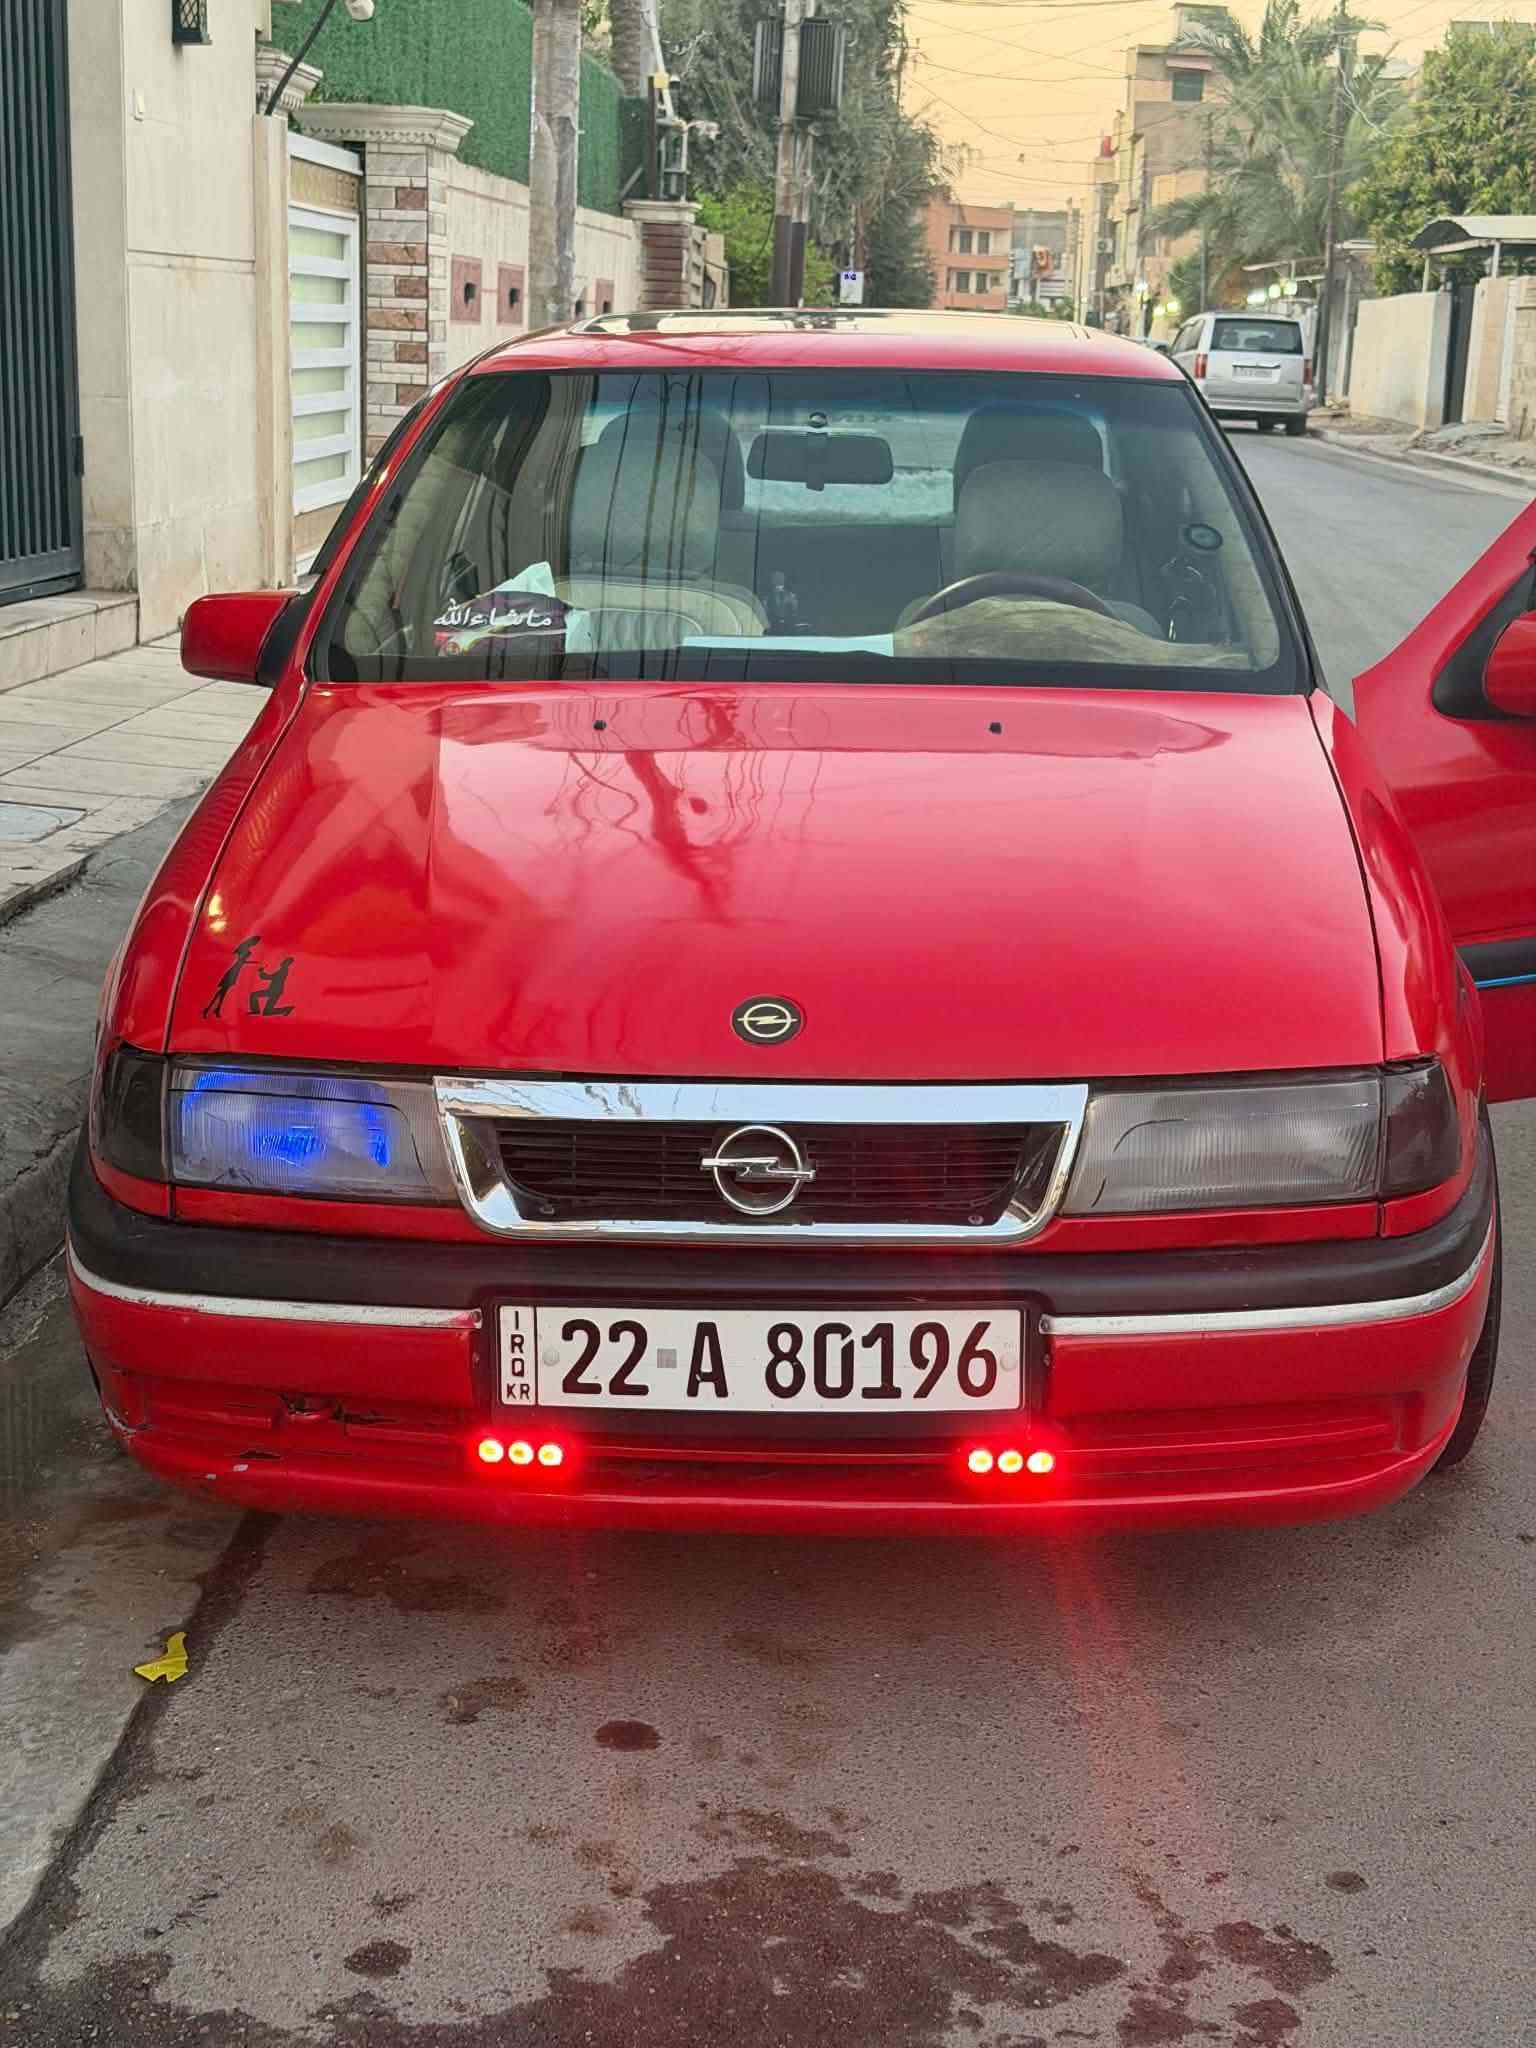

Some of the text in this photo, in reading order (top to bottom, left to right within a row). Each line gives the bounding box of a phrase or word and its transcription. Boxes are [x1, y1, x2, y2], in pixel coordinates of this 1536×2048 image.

[561, 1318, 998, 1400] 22 A 80196
[506, 1383, 530, 1400] KR
